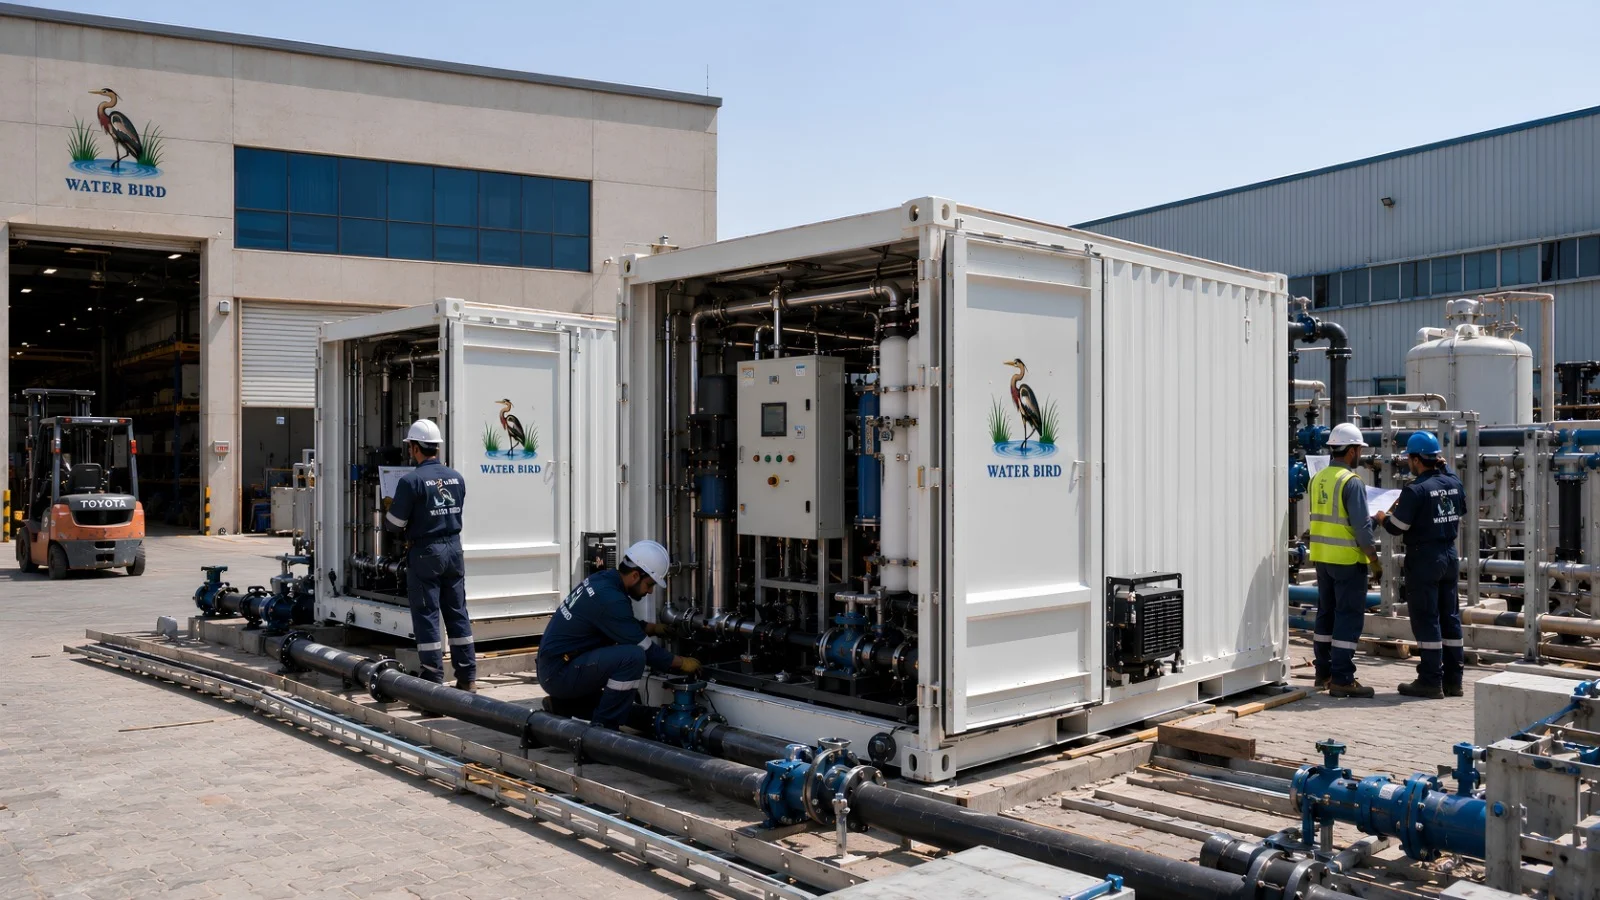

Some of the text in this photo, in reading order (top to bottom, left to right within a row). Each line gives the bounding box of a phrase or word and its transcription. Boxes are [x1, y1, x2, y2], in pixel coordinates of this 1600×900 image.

[65, 178, 167, 198] WATER BIRD
[480, 464, 541, 474] WATER BIRD
[987, 464, 1062, 478] WATER BIRD
[80, 499, 127, 508] TOYOTA
